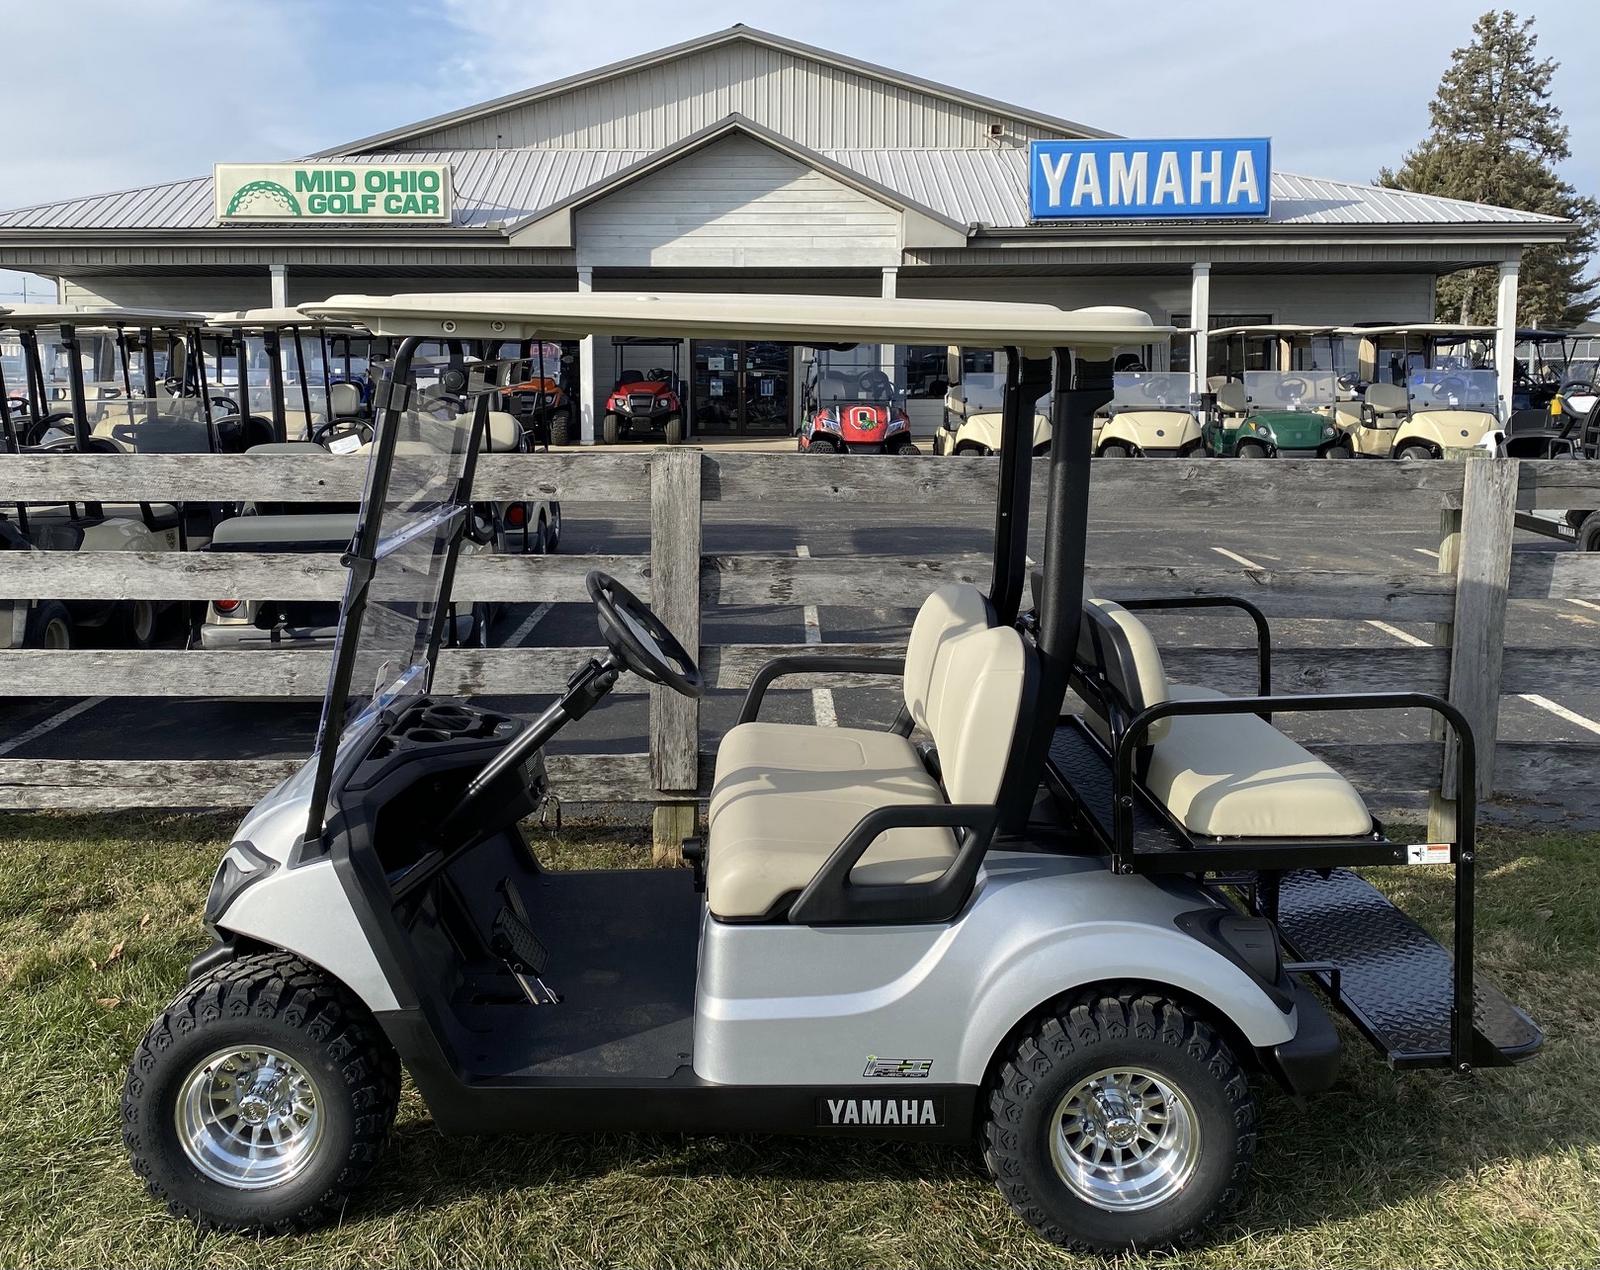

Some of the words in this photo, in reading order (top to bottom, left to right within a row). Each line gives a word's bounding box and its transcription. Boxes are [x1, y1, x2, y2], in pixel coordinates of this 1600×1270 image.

[295, 170, 357, 193] MID
[364, 170, 440, 193] OHIO
[1039, 150, 1261, 207] YAMAHA
[307, 194, 377, 214] GOLF
[384, 194, 440, 214] CAR
[827, 1099, 937, 1125] YAMAHA
